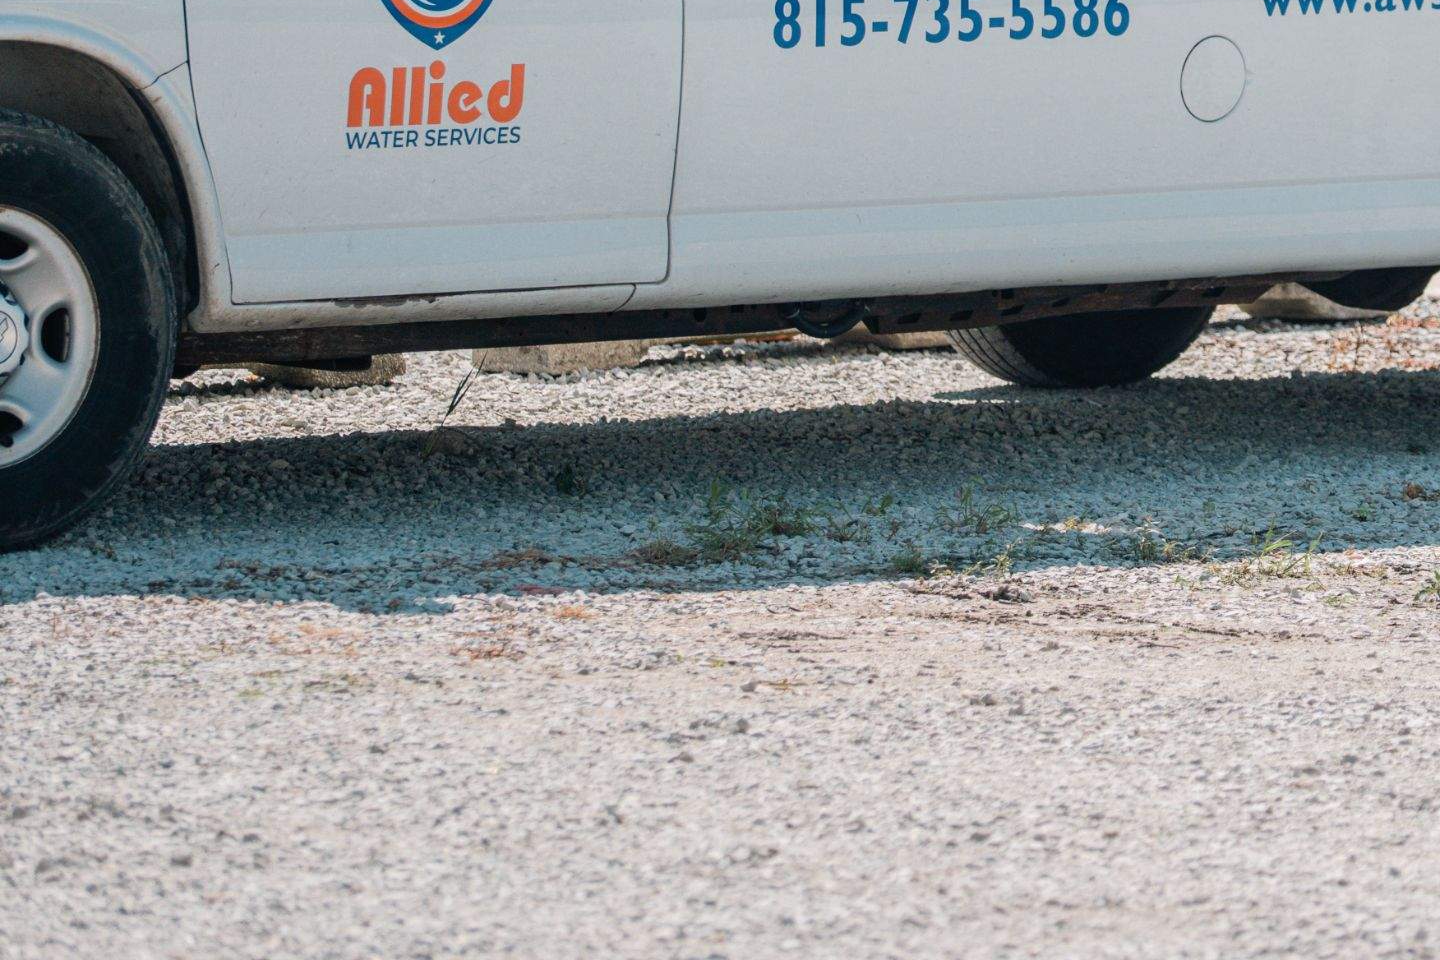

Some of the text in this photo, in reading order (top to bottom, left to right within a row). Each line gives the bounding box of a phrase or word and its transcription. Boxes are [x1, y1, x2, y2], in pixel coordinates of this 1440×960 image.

[347, 59, 526, 128] Allied
[346, 126, 521, 149] WATER SERVICES
